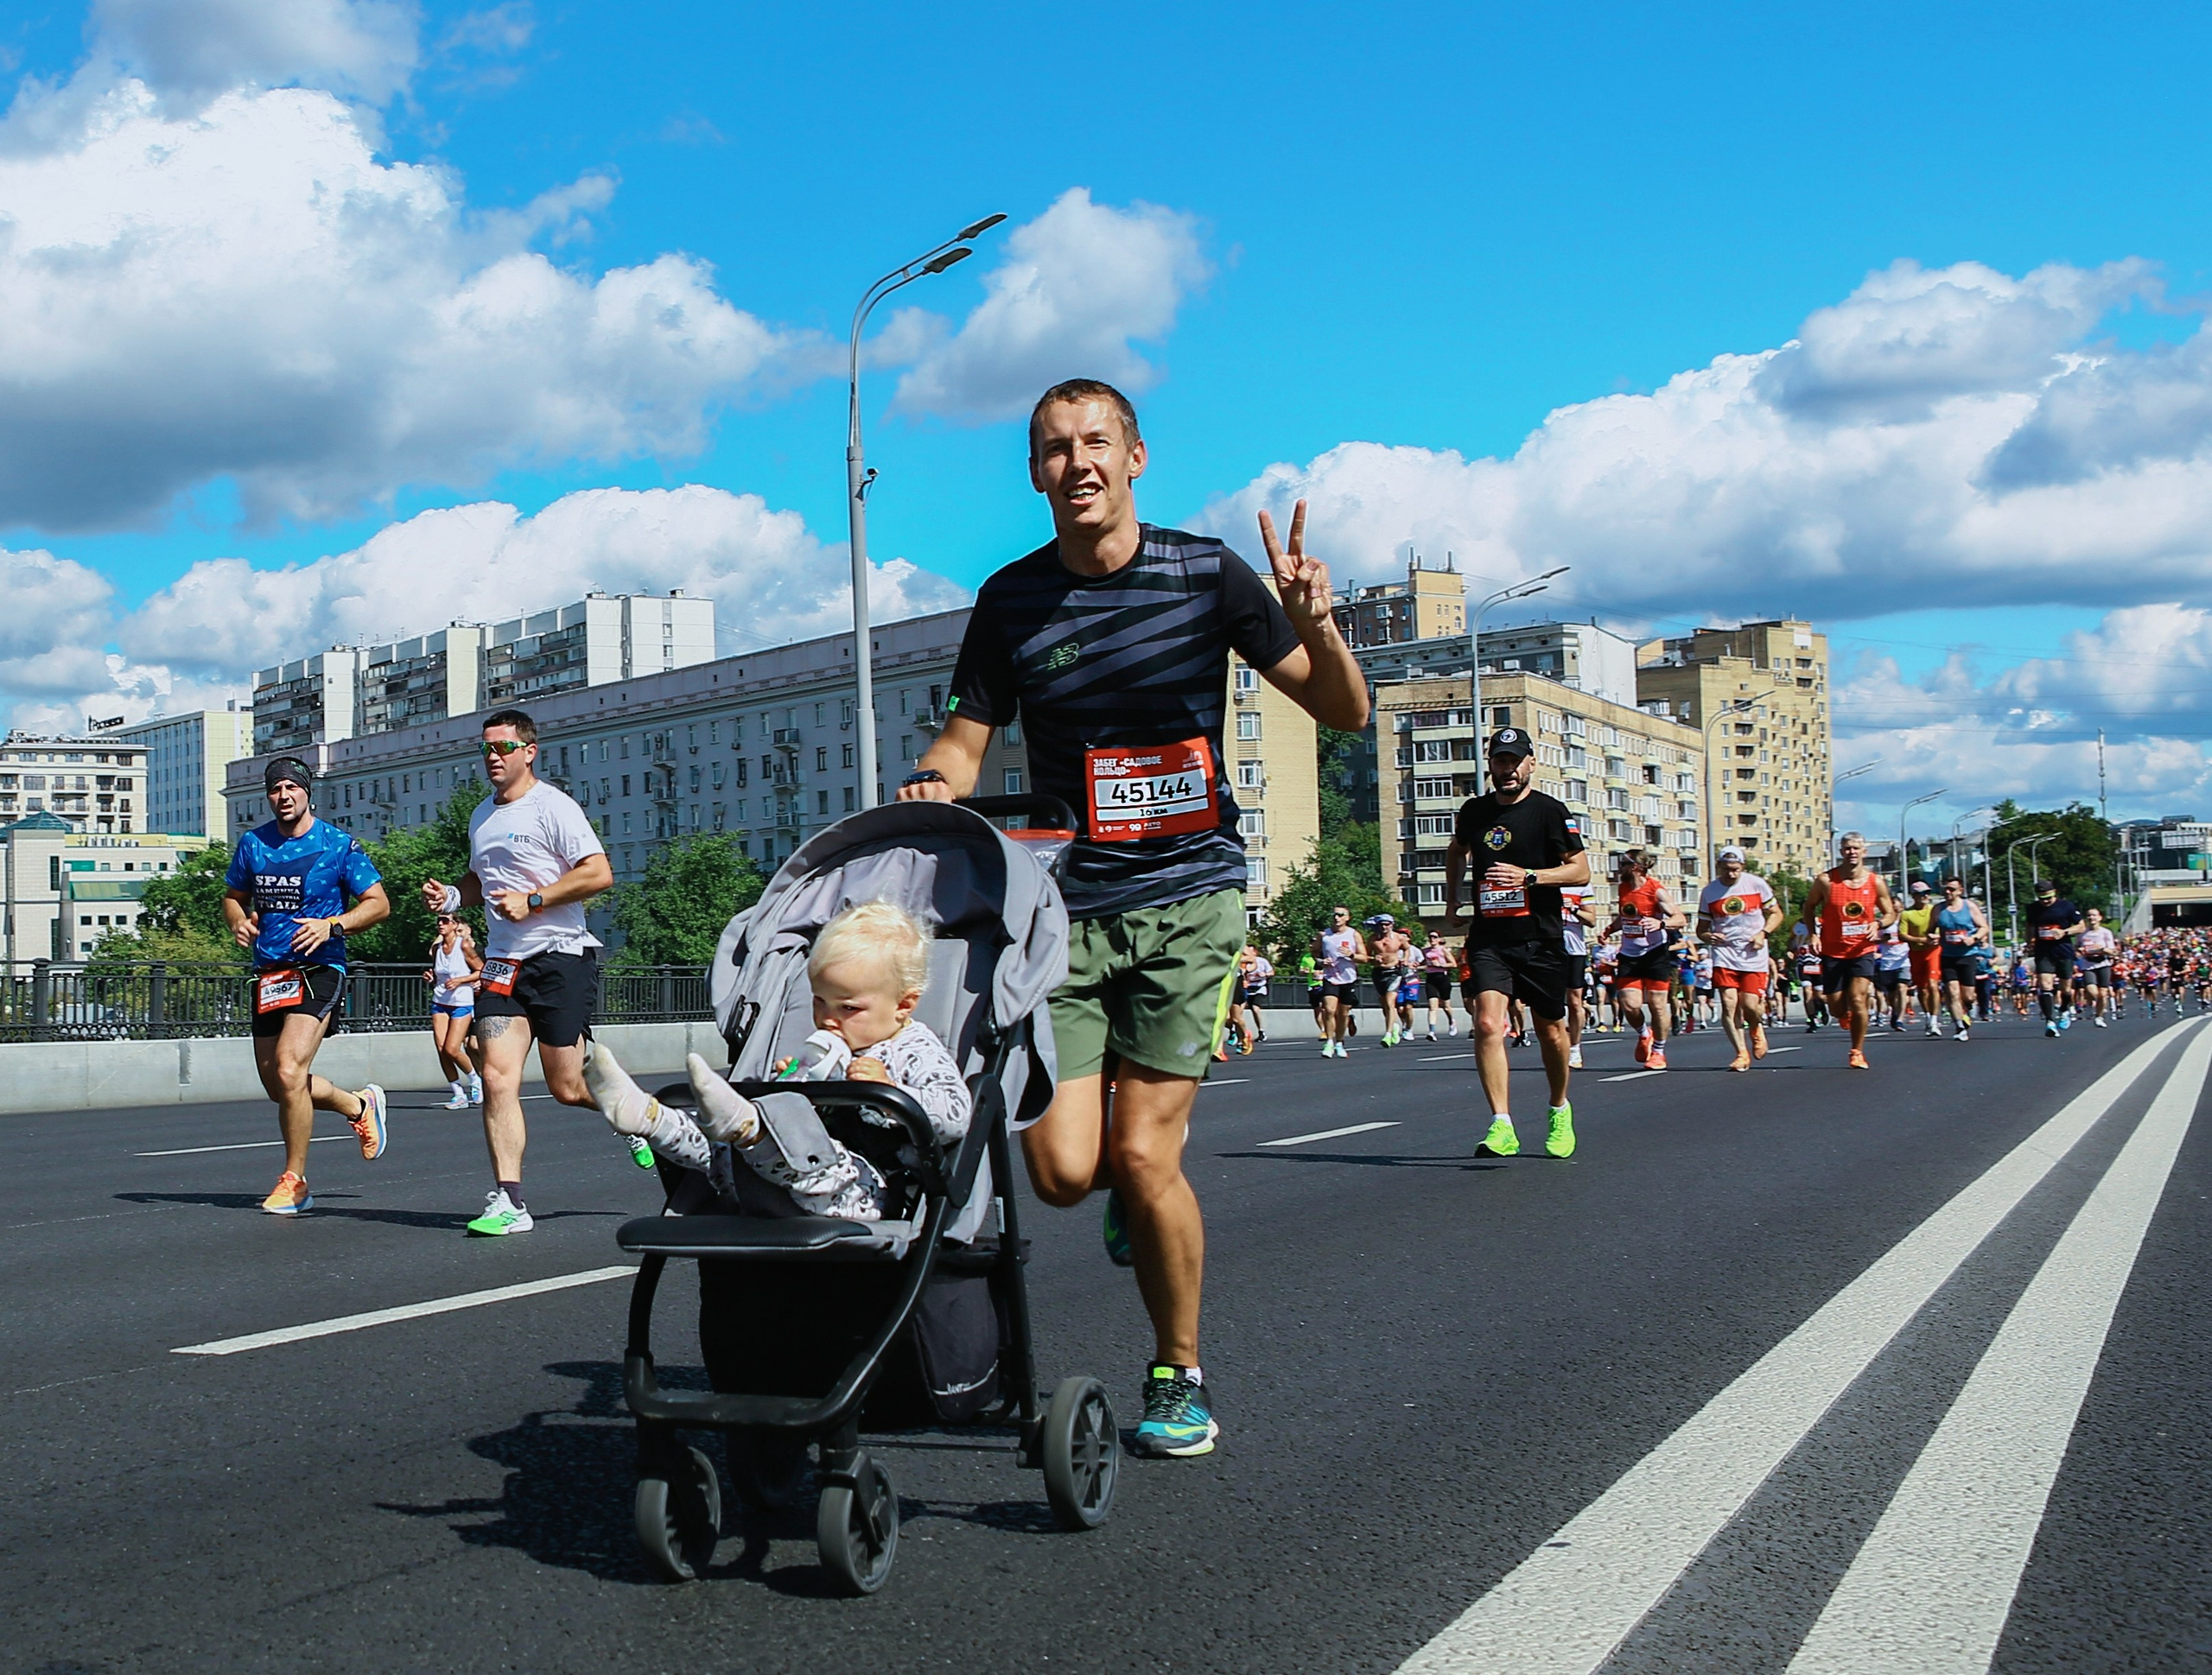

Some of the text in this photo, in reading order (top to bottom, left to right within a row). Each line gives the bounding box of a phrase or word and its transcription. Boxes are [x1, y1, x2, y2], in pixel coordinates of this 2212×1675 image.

[1111, 777, 1192, 803] 45144
[1140, 809, 1153, 817] 16
[513, 834, 530, 843] ВТБ
[255, 875, 302, 886] SPAS
[1484, 891, 1517, 902] 45512
